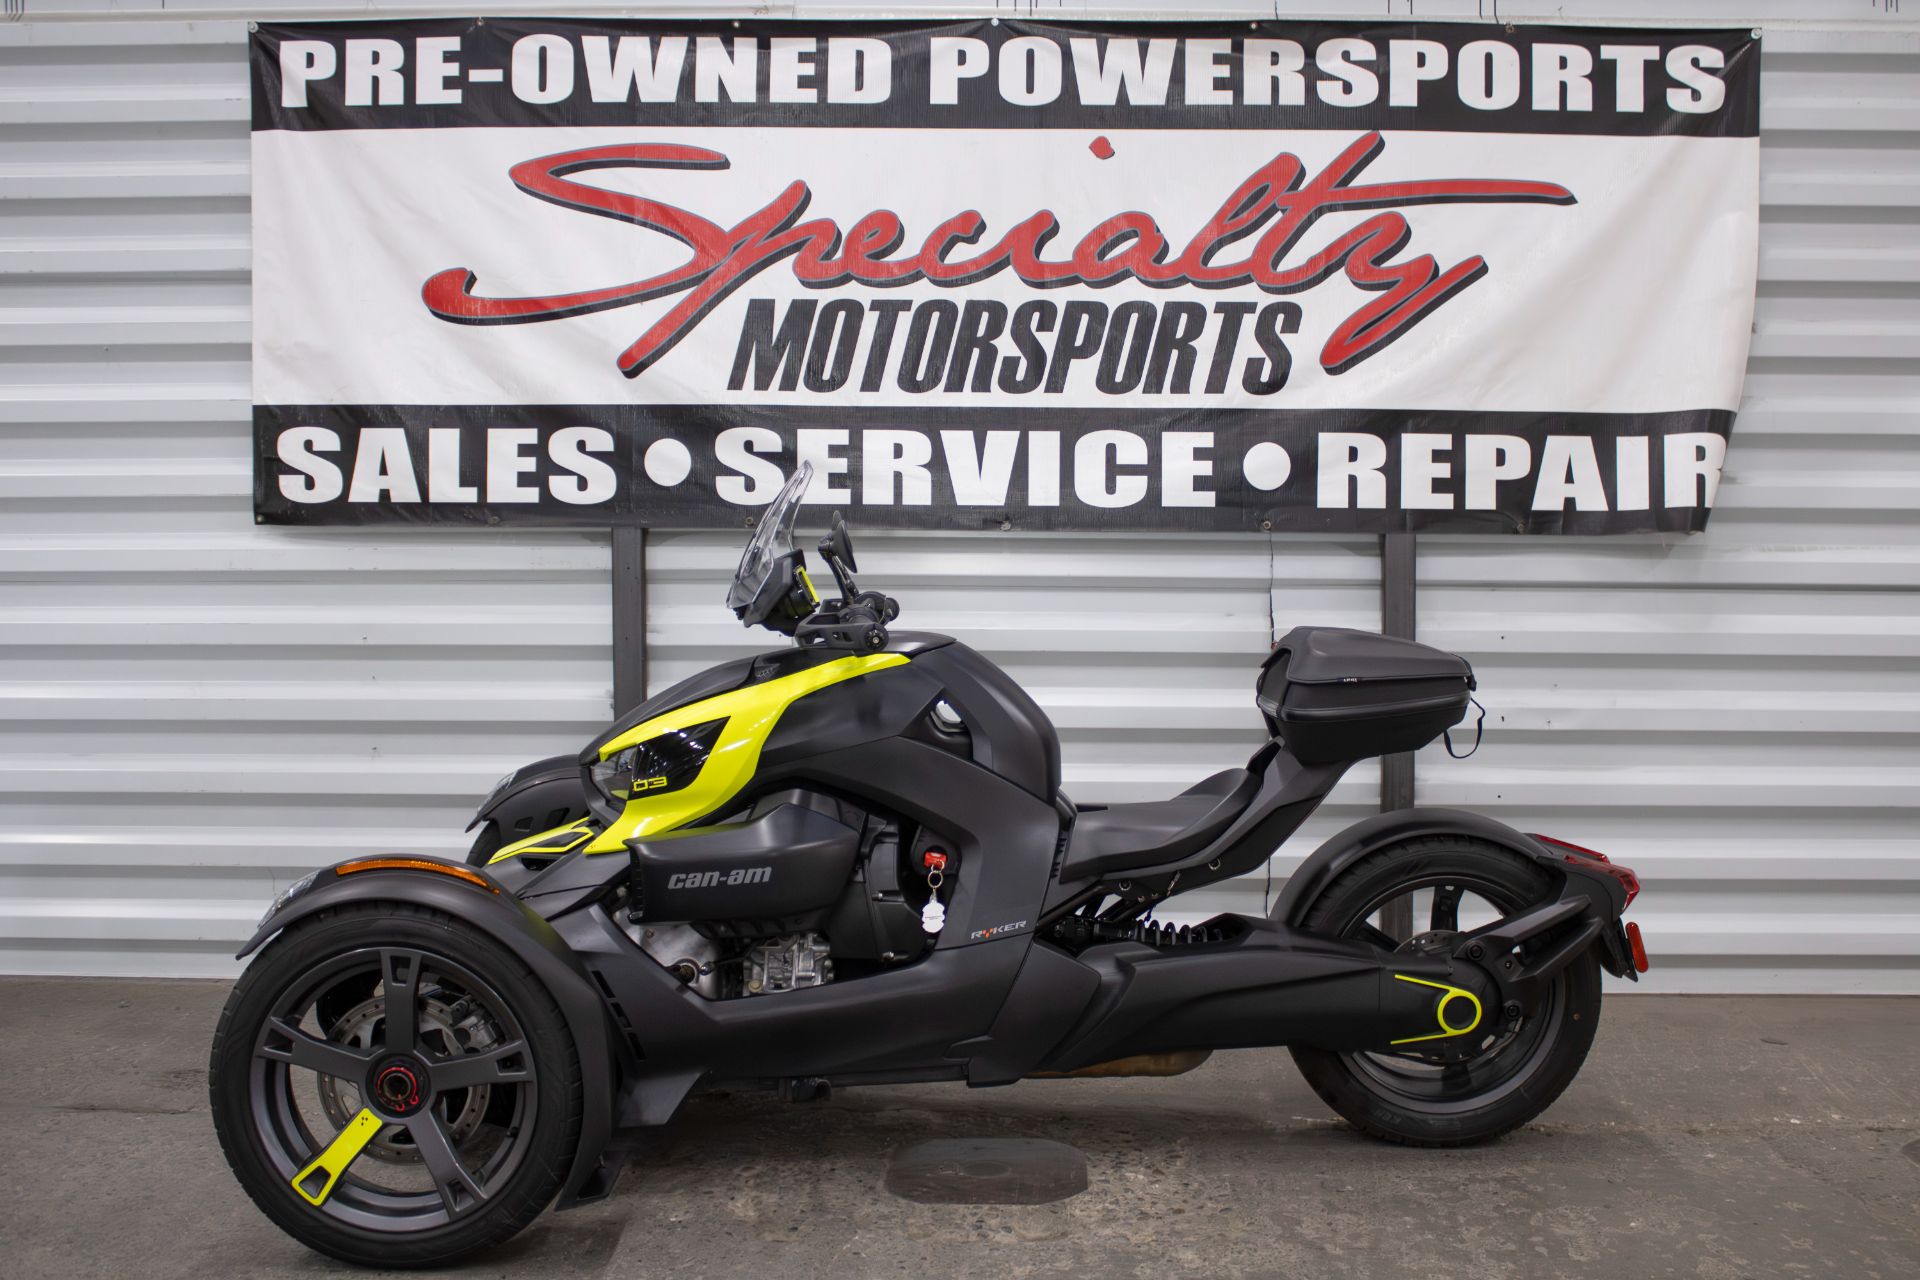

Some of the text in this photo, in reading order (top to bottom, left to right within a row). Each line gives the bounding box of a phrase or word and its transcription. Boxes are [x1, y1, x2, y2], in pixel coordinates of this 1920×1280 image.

[279, 33, 1726, 114] PRE-OWNED POWERSPORTS
[422, 129, 1577, 377] Specialty
[727, 298, 1303, 394] MOTORSPORTS
[275, 426, 1727, 513] SALES SERVICE REPAIR
[667, 866, 772, 890] can-am
[970, 920, 1027, 940] RYKER
